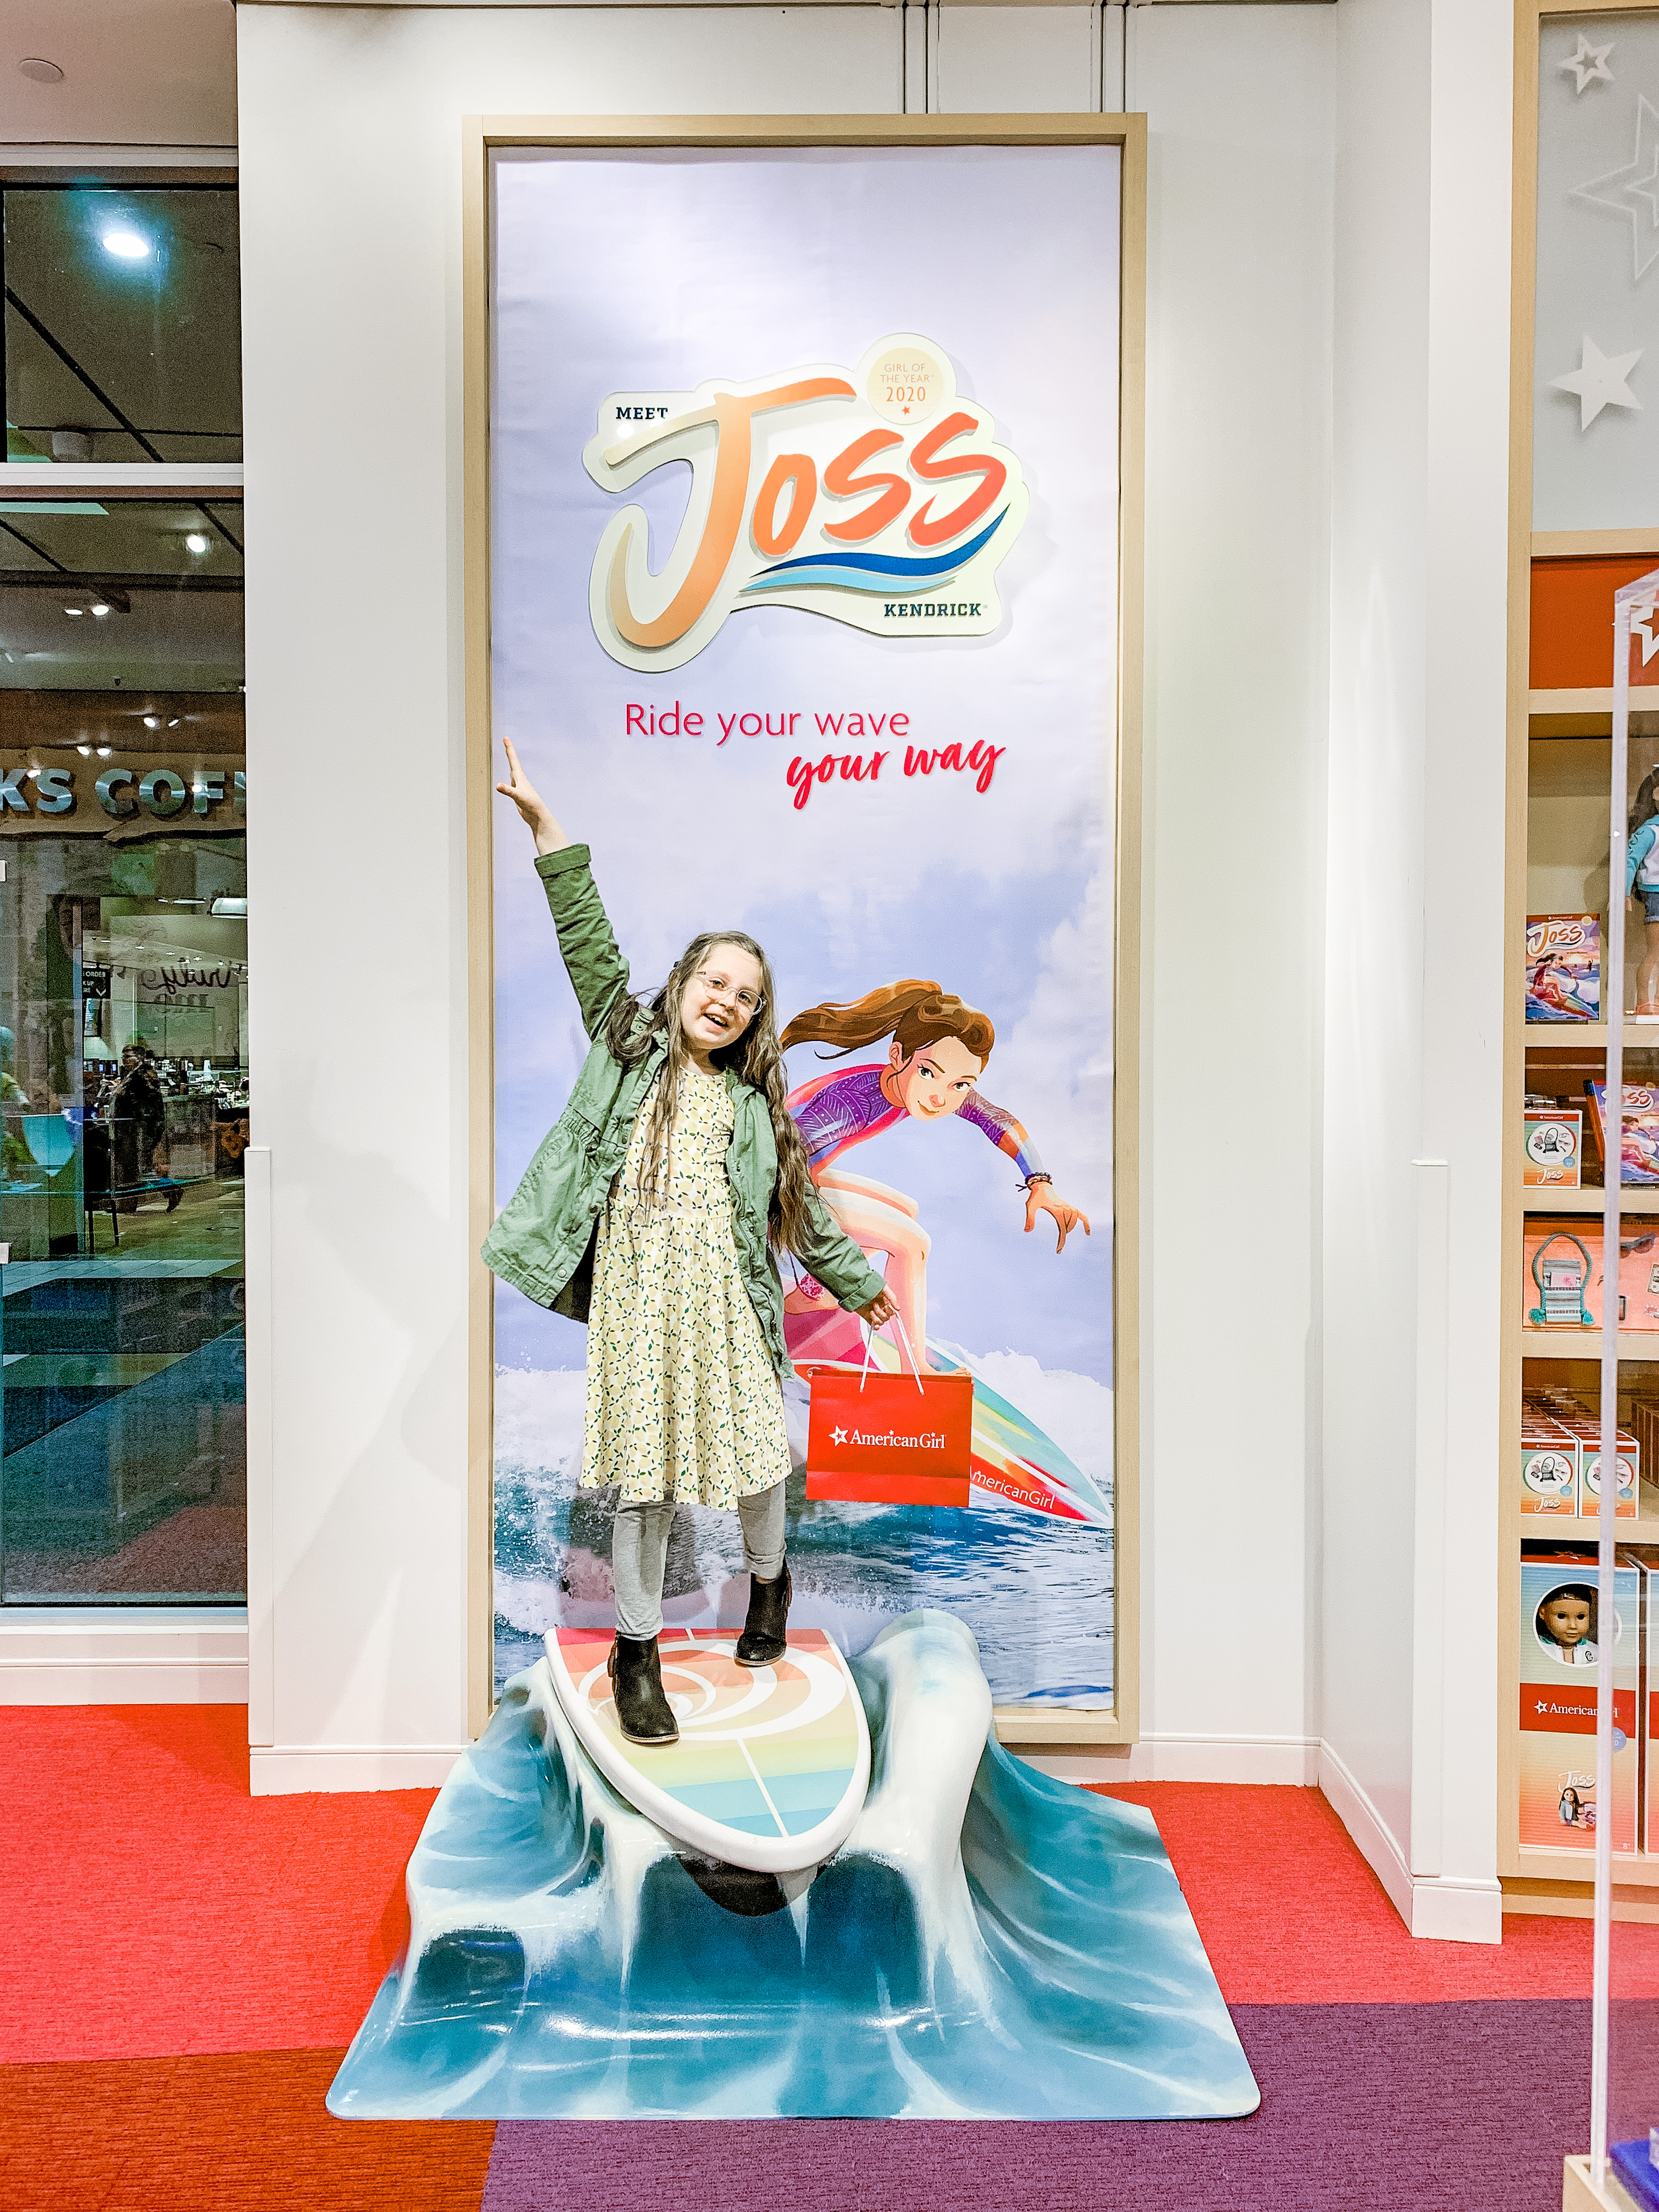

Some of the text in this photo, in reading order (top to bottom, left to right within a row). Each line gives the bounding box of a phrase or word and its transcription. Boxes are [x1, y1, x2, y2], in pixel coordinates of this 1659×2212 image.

[884, 363, 926, 372] GIRL OF
[879, 374, 900, 383] THE
[886, 386, 926, 402] 2020
[615, 406, 668, 420] MEET
[883, 603, 982, 617] KENDRICK
[625, 701, 910, 747] Ride your wave
[786, 739, 1007, 810] your way
